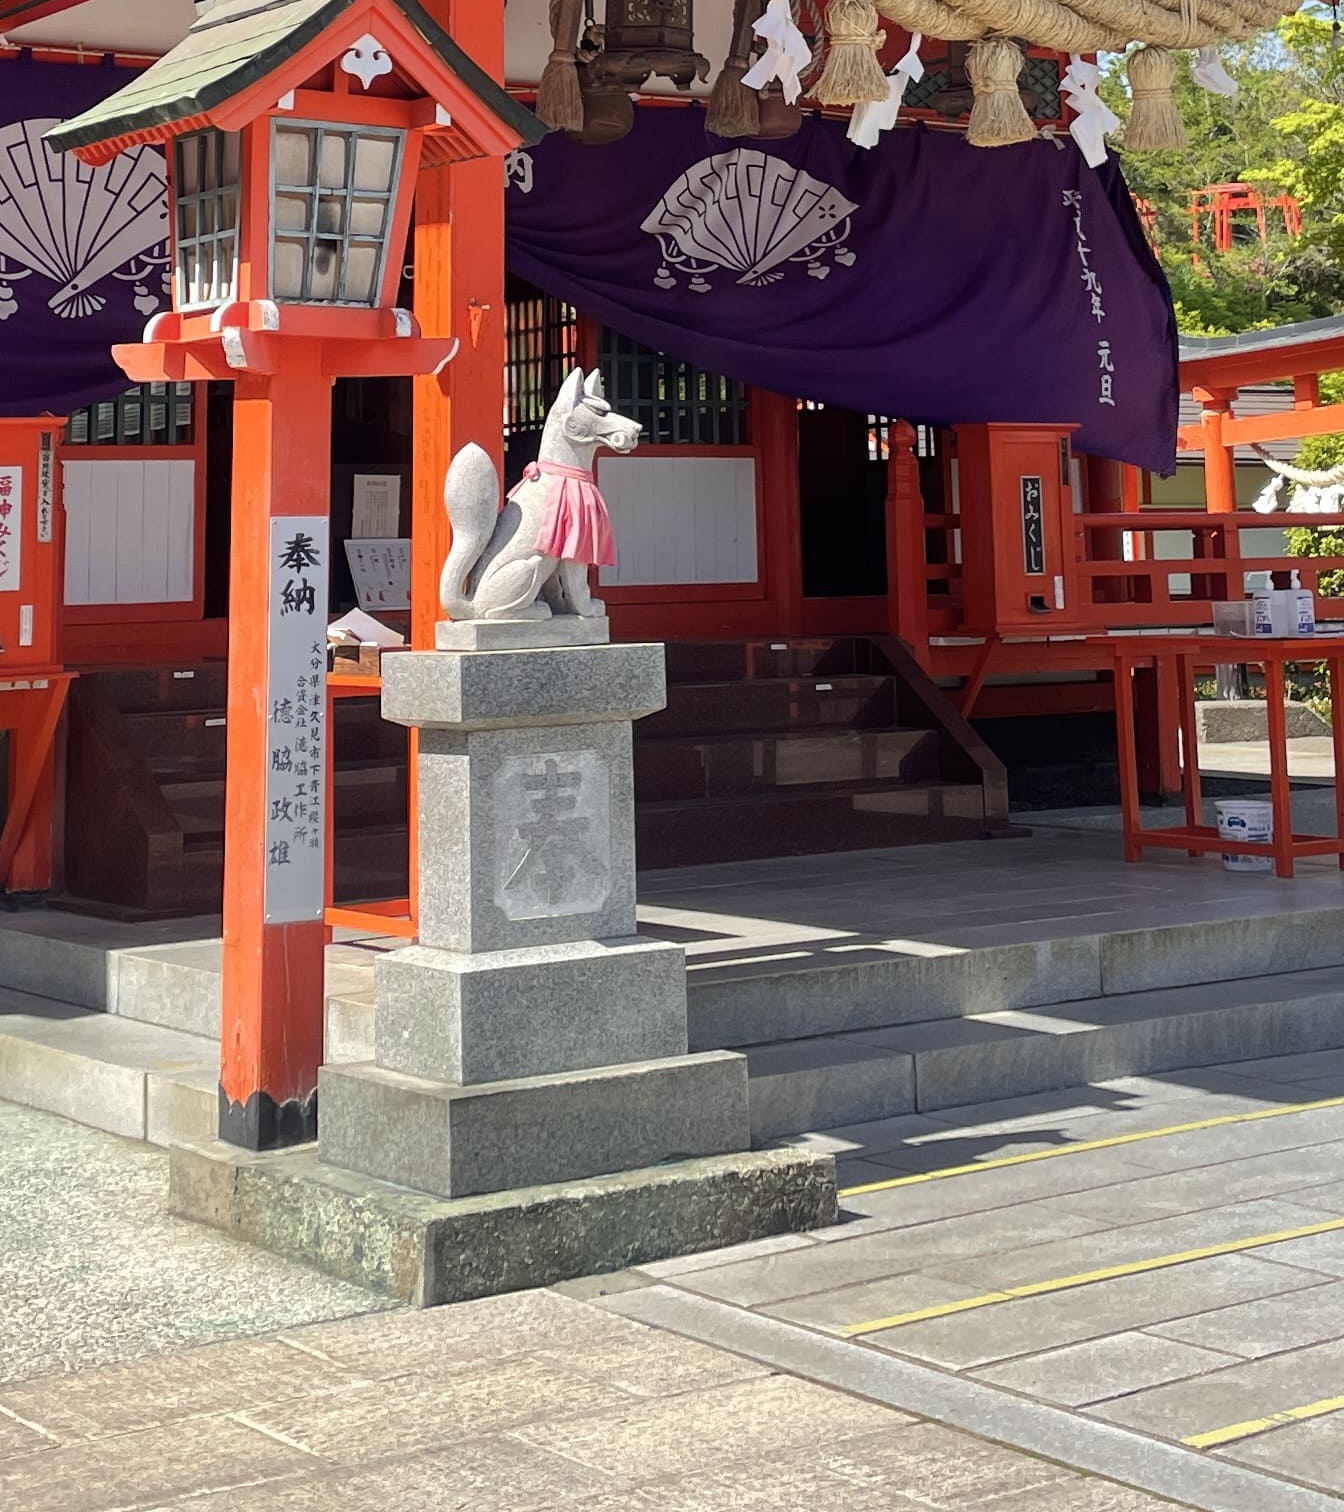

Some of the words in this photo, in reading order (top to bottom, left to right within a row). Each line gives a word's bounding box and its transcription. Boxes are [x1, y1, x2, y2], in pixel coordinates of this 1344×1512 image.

[1096, 340, 1116, 407] 元旦
[1024, 480, 1042, 571] おみくじ
[277, 532, 322, 617] 奉納
